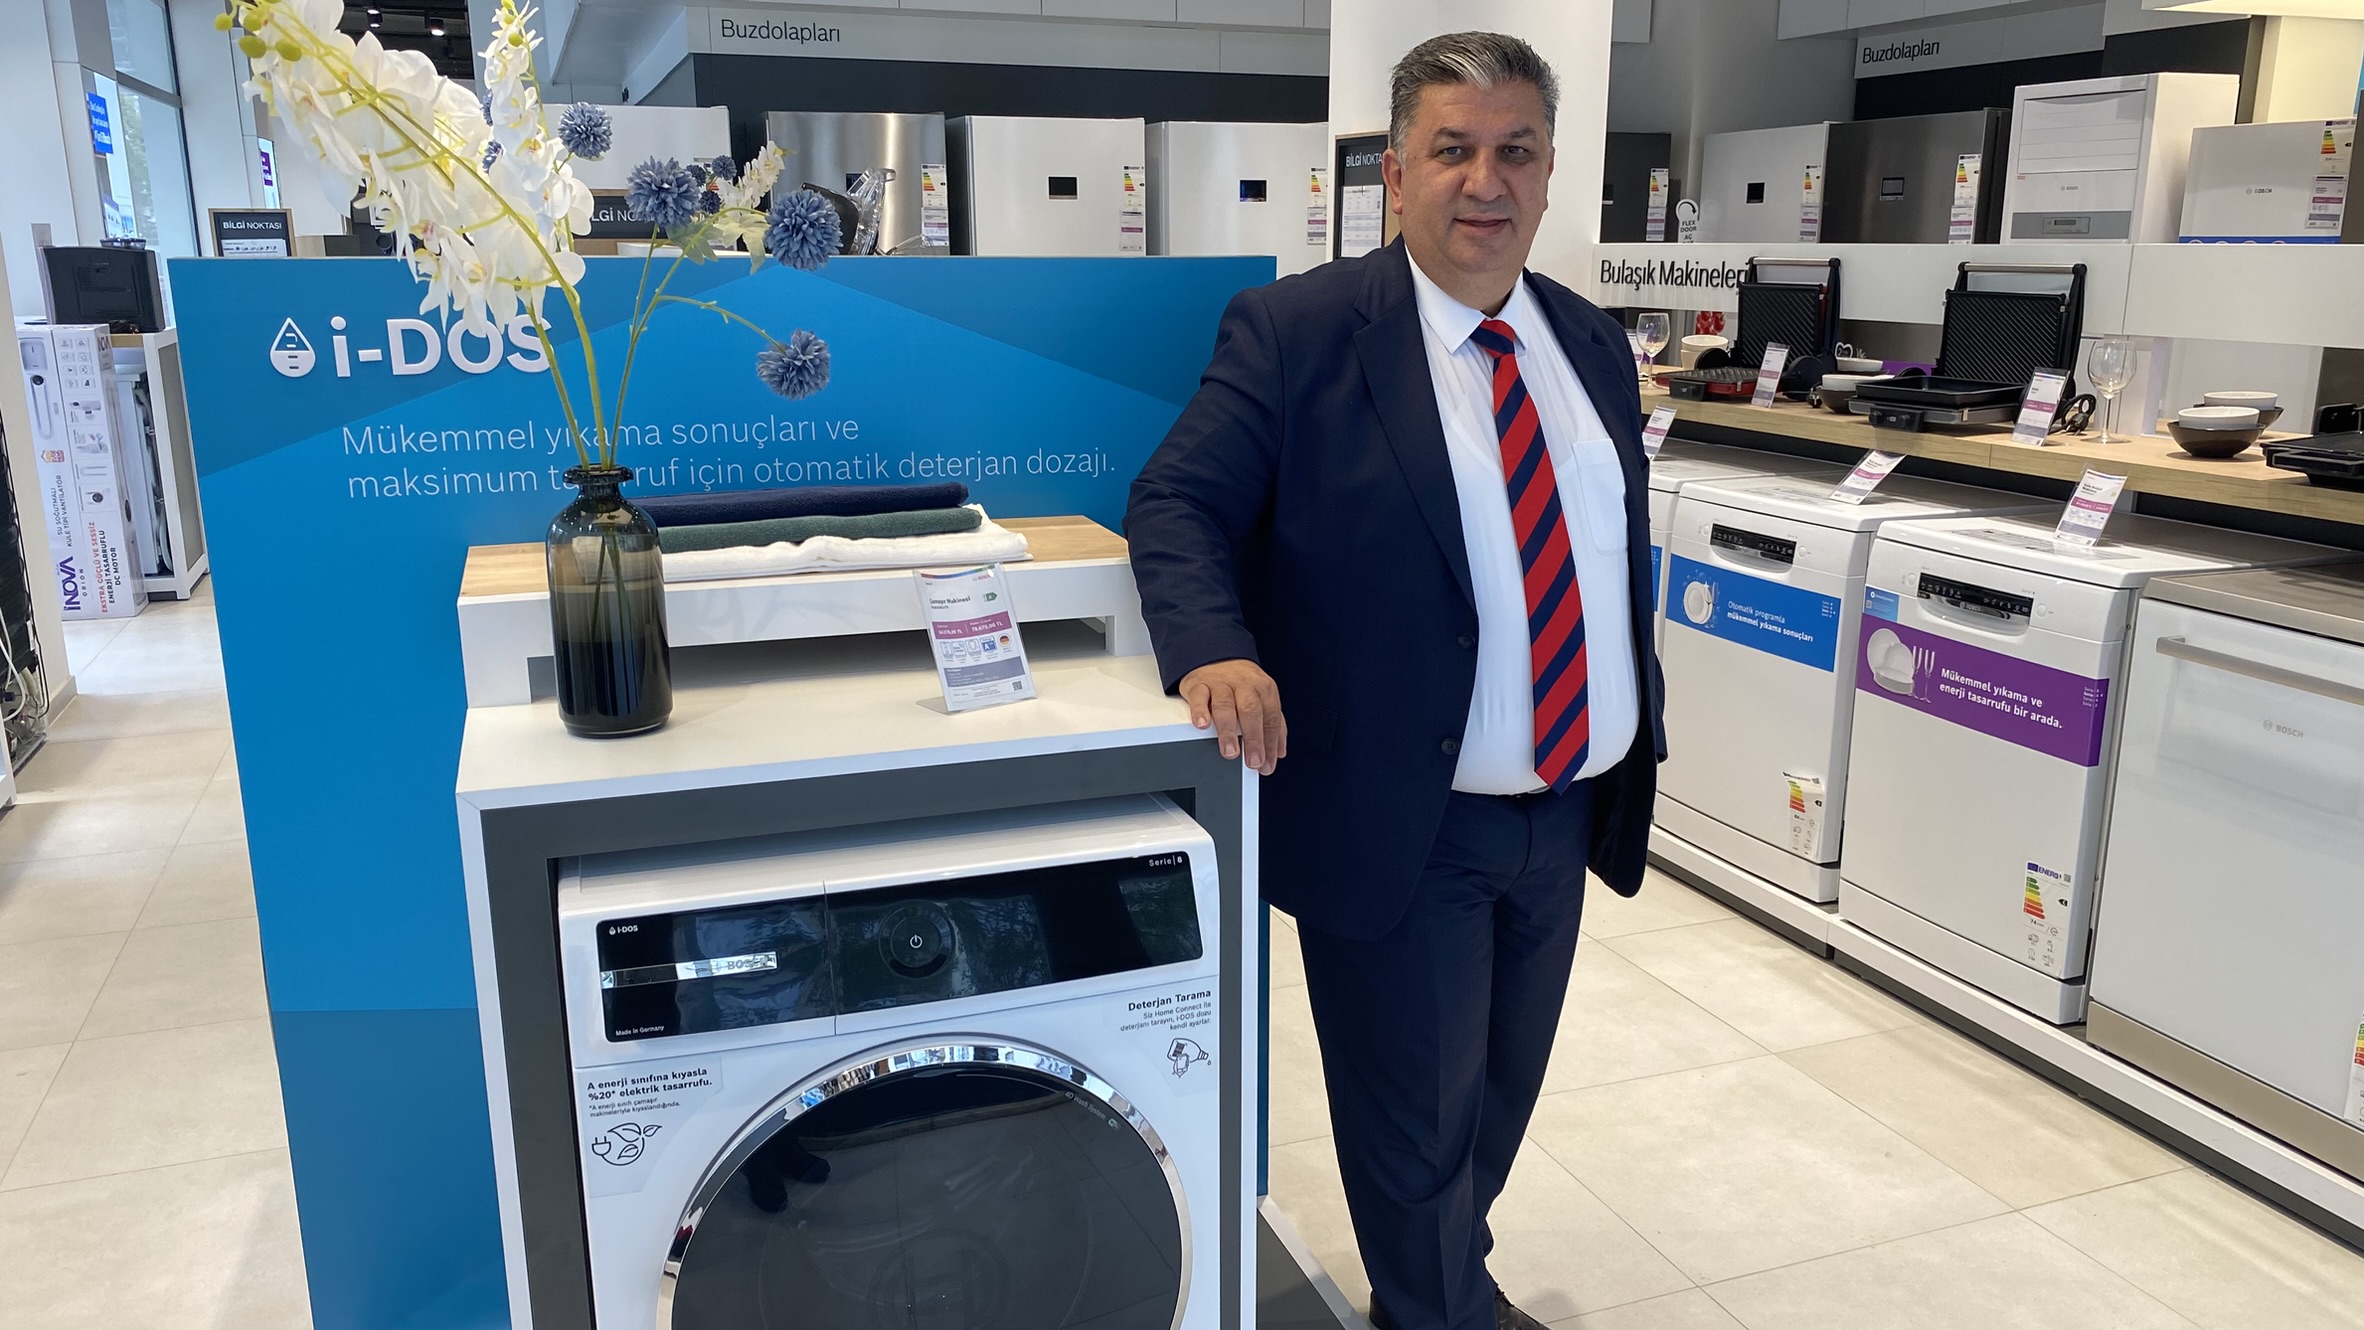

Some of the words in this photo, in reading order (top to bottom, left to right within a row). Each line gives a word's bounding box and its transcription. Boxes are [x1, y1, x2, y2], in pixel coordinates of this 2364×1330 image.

[721, 19, 840, 45] Buzdolapları
[1862, 39, 1940, 64] Buzdolapları
[1346, 152, 1361, 167] BİLGİ
[1362, 153, 1382, 167] NOKTA
[223, 220, 245, 229] BİLGİ
[247, 222, 282, 230] NOKTASI
[591, 206, 614, 222] LGİ
[1600, 259, 1656, 291] Bulaşık
[330, 314, 555, 378] i-DOS
[342, 420, 535, 455] Mükemmel
[544, 418, 663, 455] yıkama
[671, 415, 817, 449] sonuçları
[825, 420, 859, 441] ve
[348, 466, 538, 498] maksimum
[547, 458, 680, 491] truf
[690, 457, 744, 491] için
[753, 453, 890, 483] otomatik
[898, 451, 1017, 482] deterjan
[1026, 448, 1116, 478] dozajı.
[92, 548, 99, 558] VE
[98, 530, 111, 577] TASARRUFLU
[110, 547, 119, 574] MOTOR
[79, 568, 88, 597] ORION
[114, 575, 121, 586] DC
[97, 585, 108, 613] EKSTRA
[1727, 600, 1754, 615] Otomatik
[1754, 608, 1786, 625] programla
[1727, 611, 1759, 627] mükemmel
[1759, 621, 1782, 634] yıkama
[1782, 627, 1814, 643] sonuçları
[1941, 668, 1991, 693] Mükemmel
[1993, 685, 2028, 704] yıkama
[2030, 697, 2043, 708] ve
[1939, 683, 1966, 699] enerji
[1967, 691, 2011, 713] tasarrufu
[2013, 704, 2028, 718] bir
[2030, 711, 2063, 729] arada.
[2275, 724, 2304, 739] BOSCH
[1128, 997, 1172, 1011] Deterjan
[1175, 990, 1211, 1003] Tarama
[1154, 1009, 1174, 1017] Home
[1175, 1004, 1202, 1013] Connect
[616, 1029, 632, 1037] Made
[640, 1025, 665, 1034] Germany
[1120, 1021, 1150, 1031] deterjanı
[1196, 1010, 1212, 1018] dozu
[1169, 1022, 1188, 1031] kendi
[587, 1082, 595, 1091] A
[598, 1078, 628, 1089] enerji
[631, 1073, 669, 1085] sınıfına
[672, 1068, 707, 1081] kıyasla
[619, 1085, 660, 1098] elektrik
[663, 1078, 712, 1092] tasarrufu.
[598, 1102, 616, 1111] enerji
[1074, 1094, 1088, 1108] Wash
[590, 1107, 631, 1118] makineleriyle
